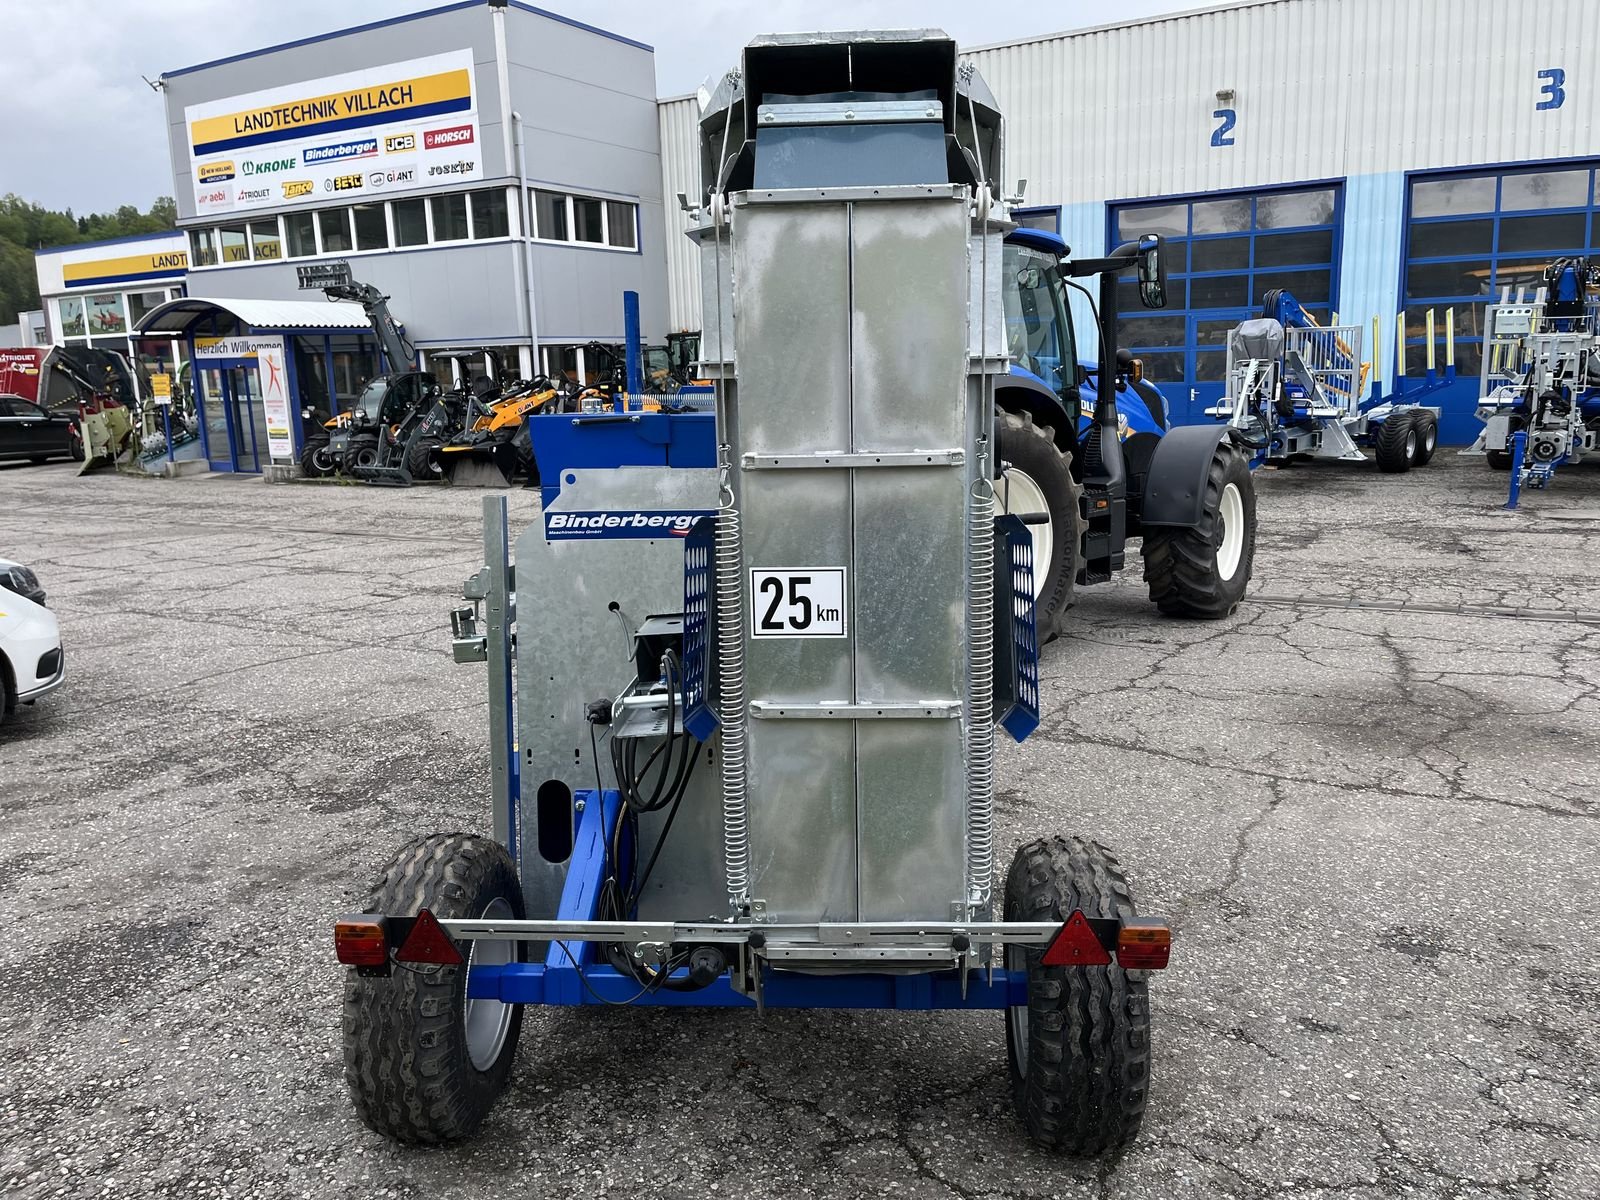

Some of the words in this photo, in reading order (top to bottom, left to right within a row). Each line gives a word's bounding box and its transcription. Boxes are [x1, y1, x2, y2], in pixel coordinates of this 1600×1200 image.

[1535, 68, 1566, 111] 3
[234, 98, 338, 133] LANDTECHNIK
[343, 85, 413, 113] VILLACH
[1210, 109, 1237, 147] 2
[386, 135, 415, 151] JCB
[434, 129, 471, 144] HORSCH
[305, 141, 376, 160] Binderberger
[255, 158, 296, 174] KRONE
[428, 160, 475, 176] JOSKIN
[209, 190, 226, 202] aebi
[196, 341, 228, 354] Herzlich
[760, 576, 812, 630] 25
[816, 603, 839, 622] km
